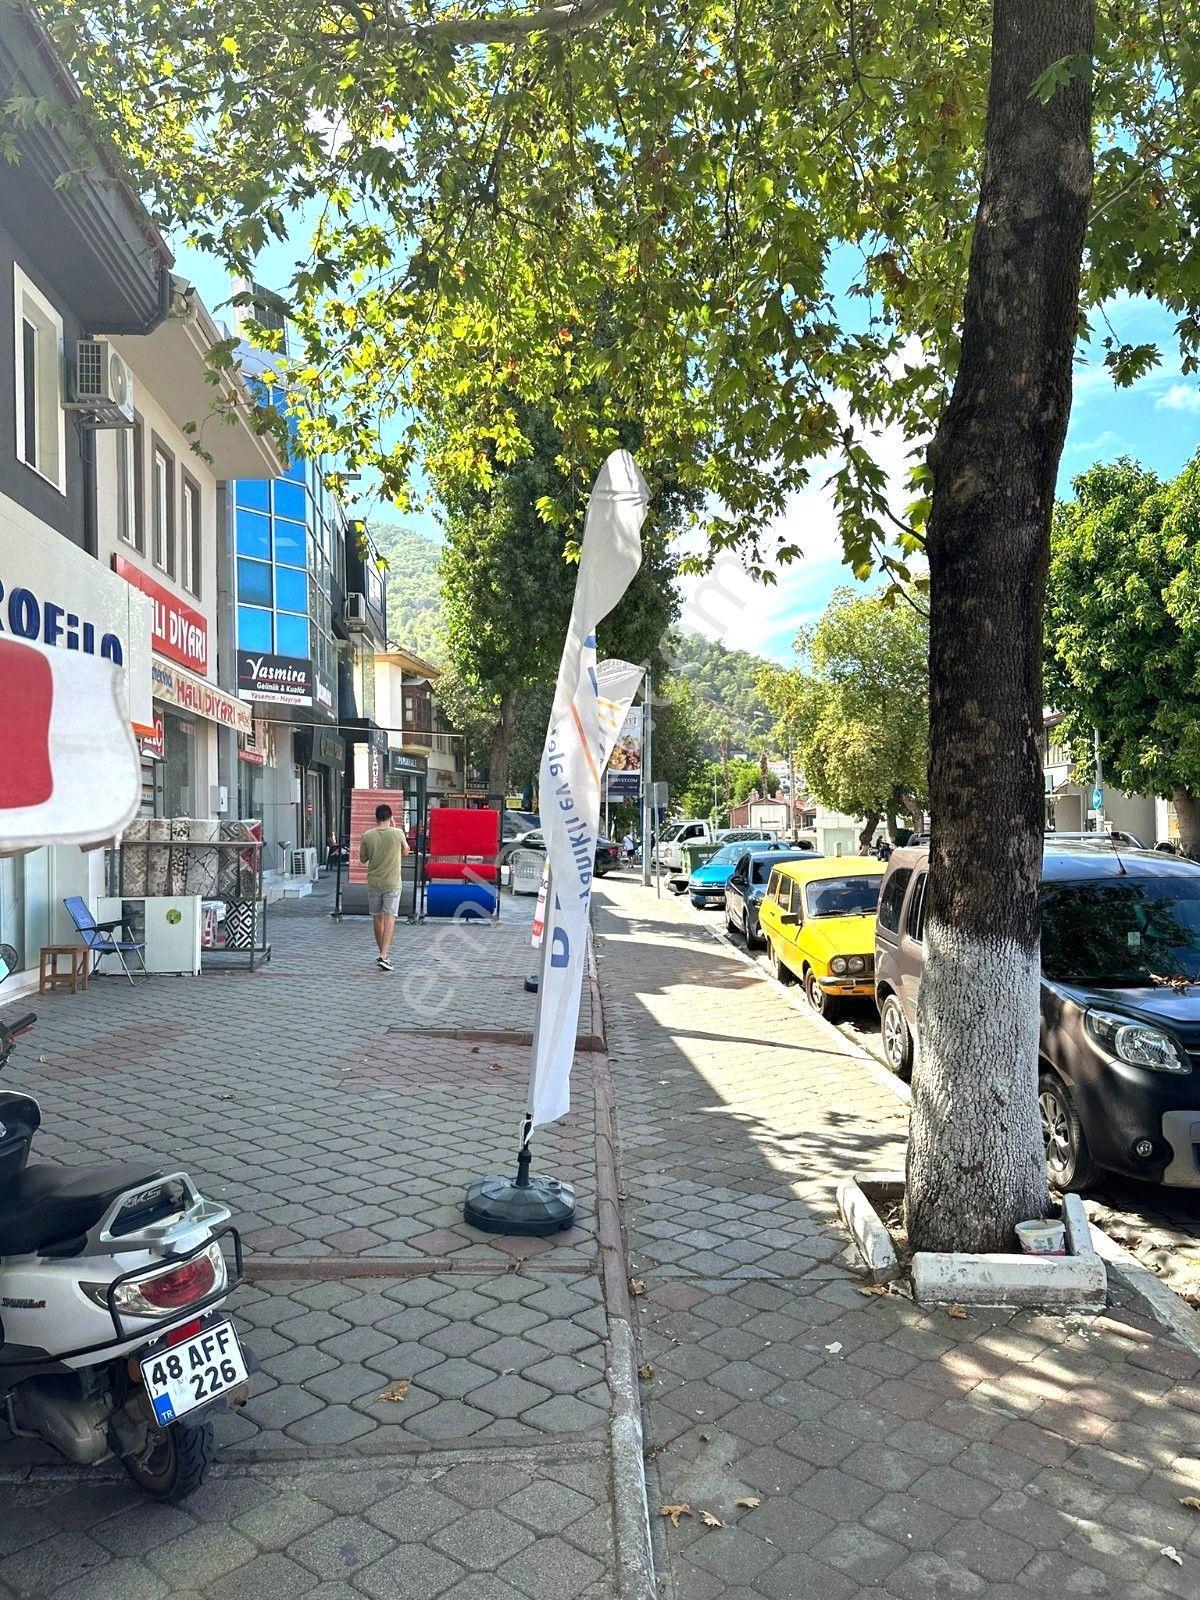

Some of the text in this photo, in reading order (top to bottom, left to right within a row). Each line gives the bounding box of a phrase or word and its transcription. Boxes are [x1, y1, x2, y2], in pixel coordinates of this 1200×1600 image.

[169, 605, 206, 664] DİYARI
[246, 656, 306, 683] Yasmira
[256, 681, 279, 692] Gelinlik
[176, 678, 202, 710] HALI
[205, 691, 236, 724] DİYARI
[251, 692, 276, 701] Yasemin
[280, 694, 302, 704] Hayriye
[151, 1328, 229, 1386] 48 AFF
[189, 1358, 237, 1402] 226
[161, 1409, 175, 1420] TR
